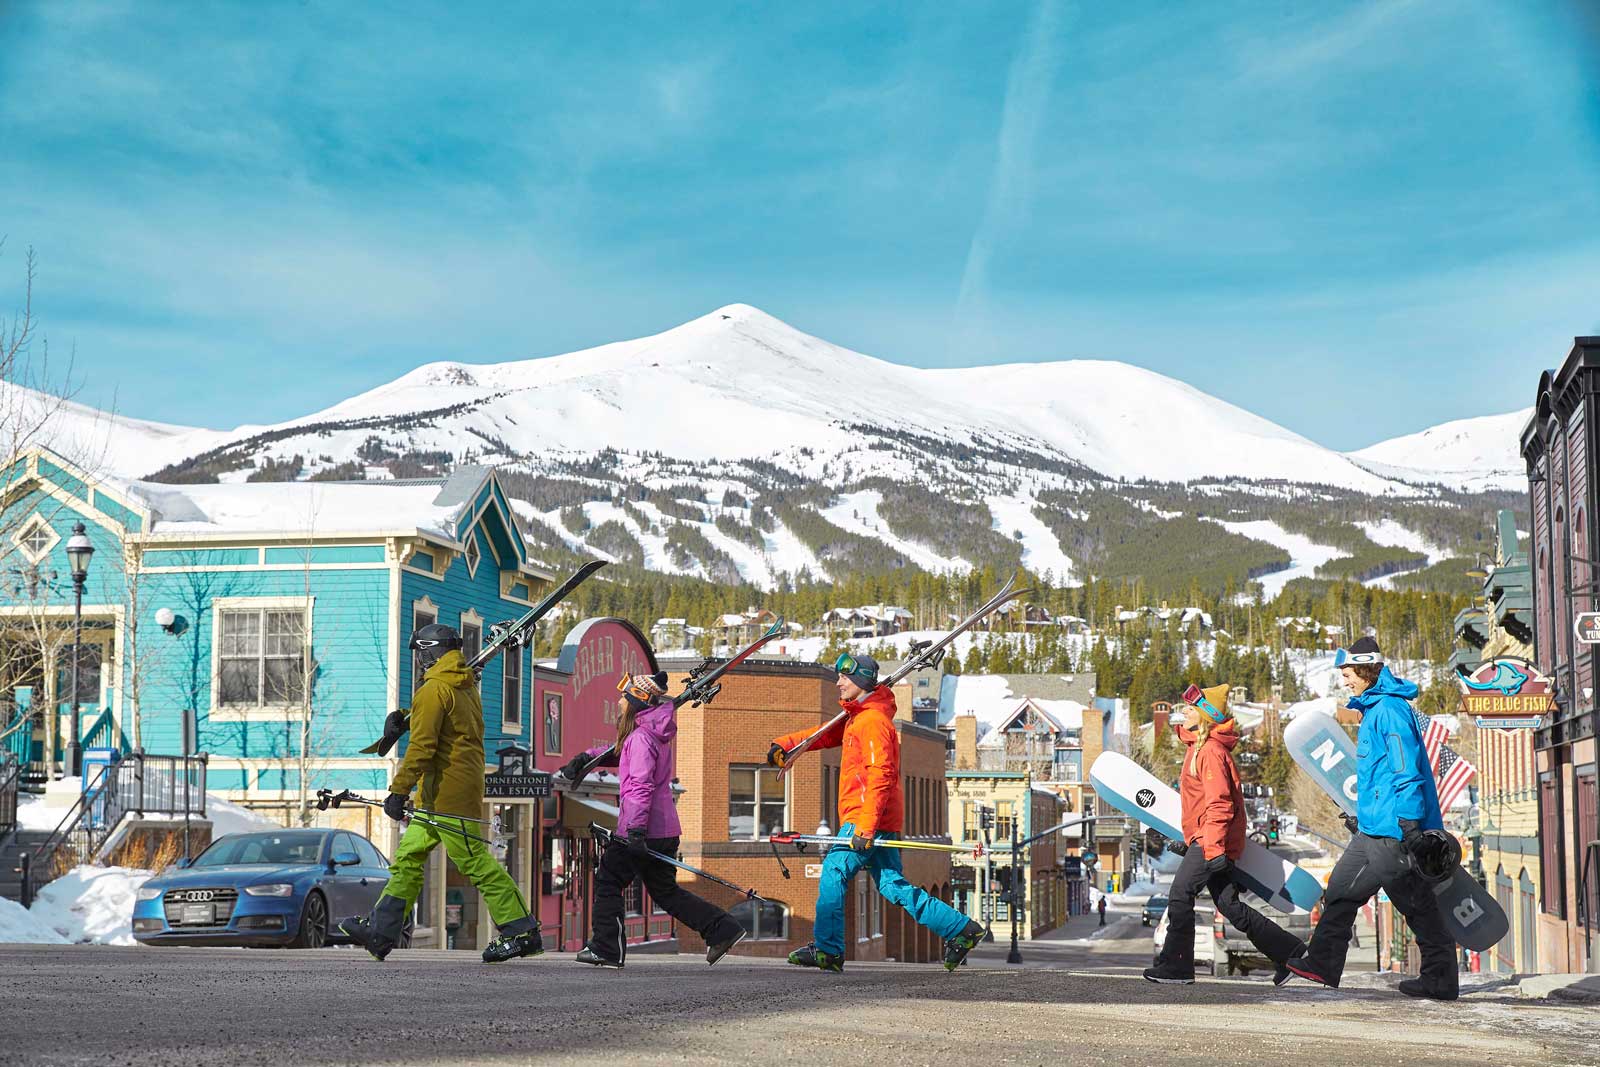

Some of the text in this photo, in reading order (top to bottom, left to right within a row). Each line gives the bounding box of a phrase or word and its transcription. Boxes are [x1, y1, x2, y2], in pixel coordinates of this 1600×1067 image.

[485, 776, 548, 785] ORNERSTONE
[485, 786, 548, 795] EAL ESTATE
